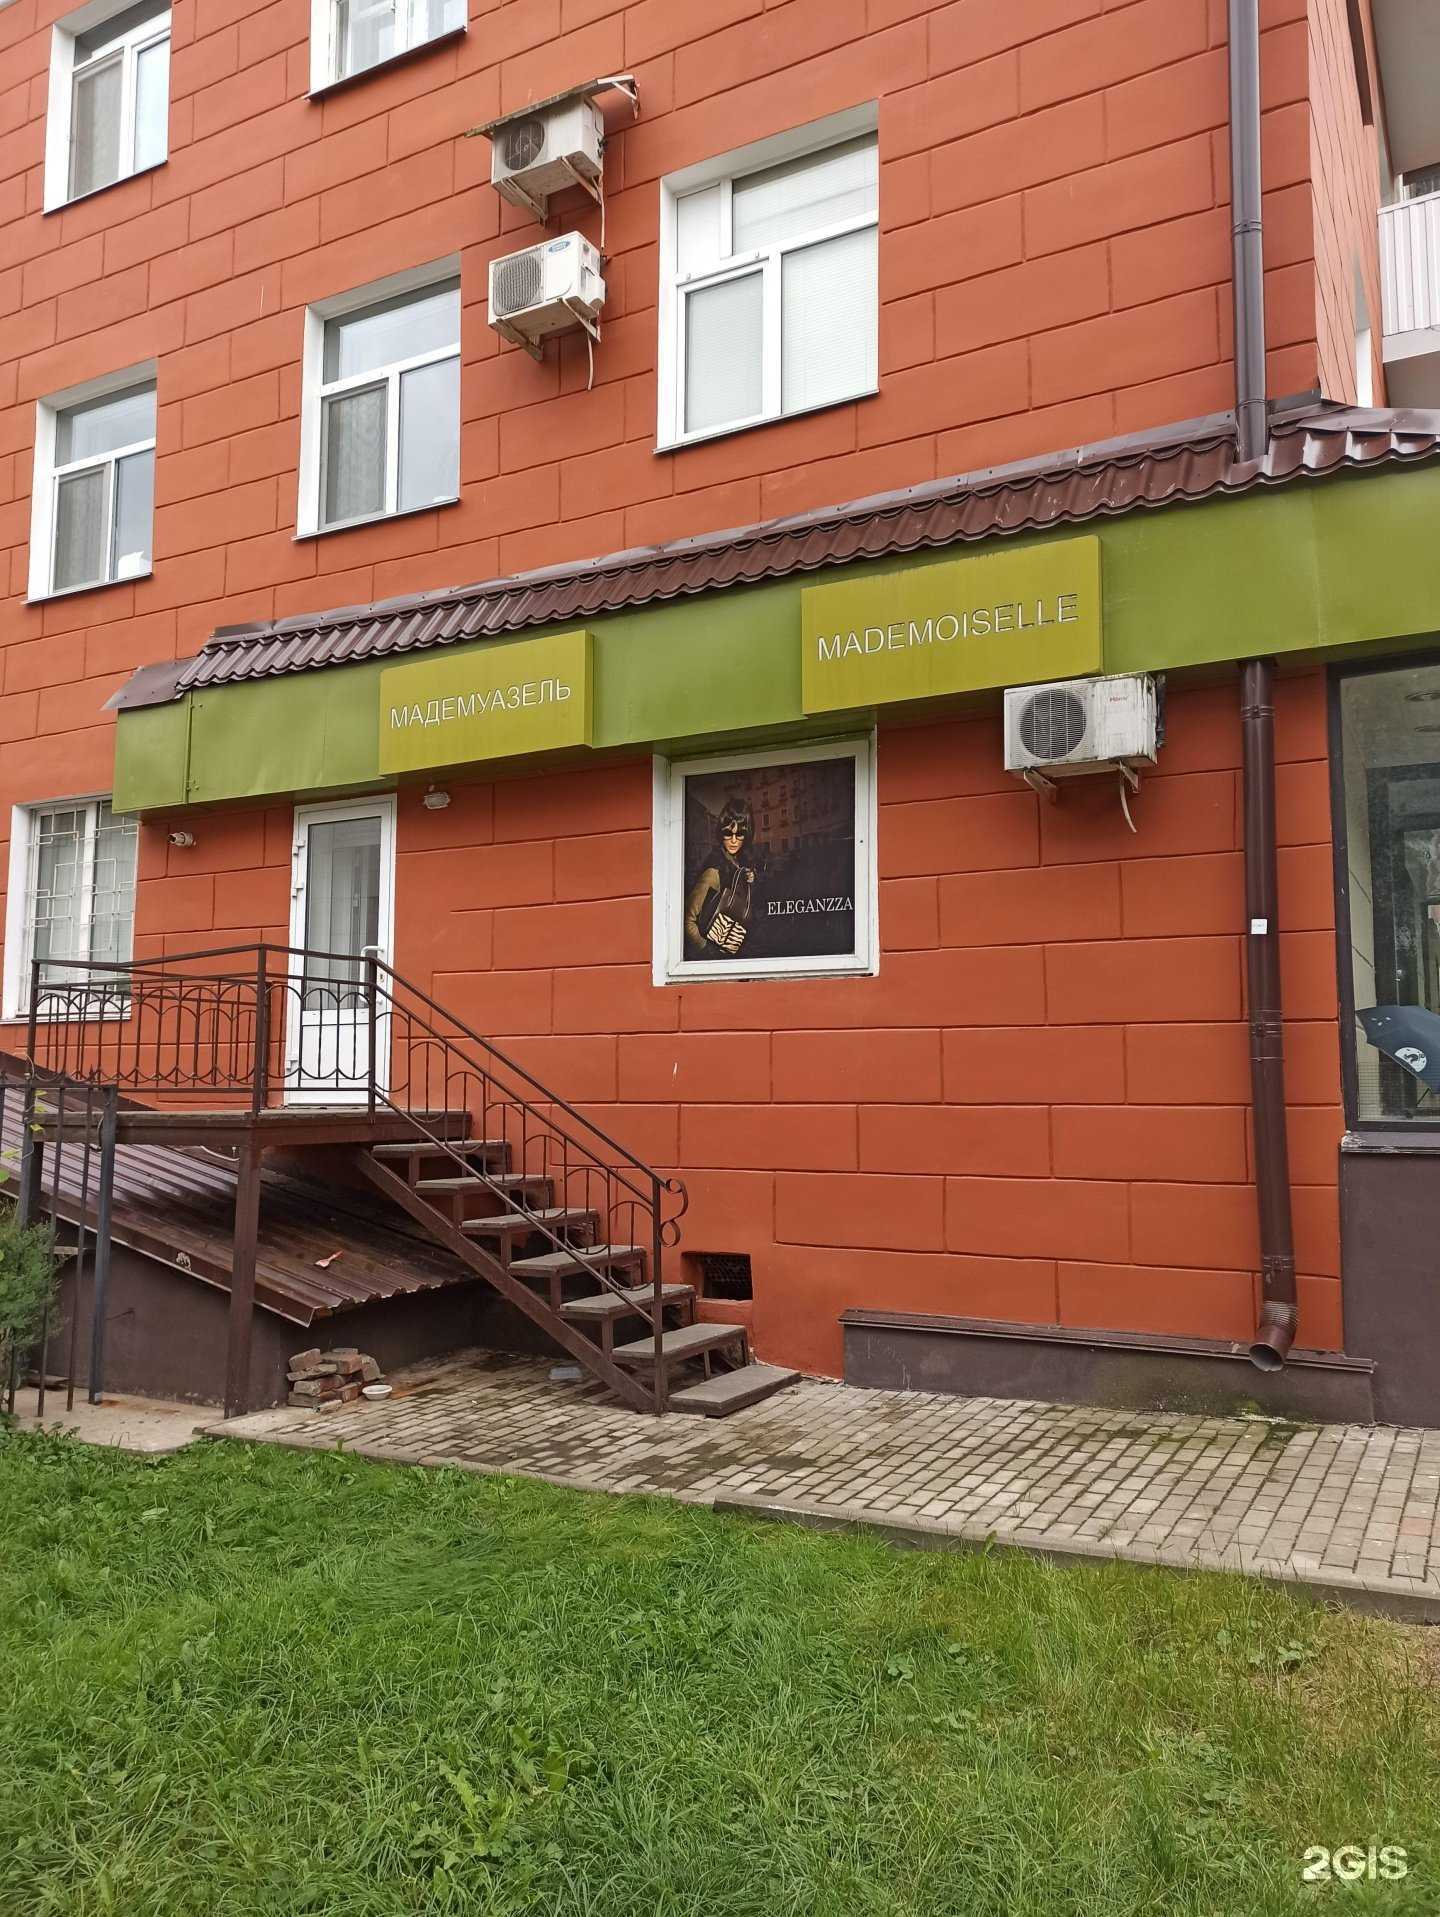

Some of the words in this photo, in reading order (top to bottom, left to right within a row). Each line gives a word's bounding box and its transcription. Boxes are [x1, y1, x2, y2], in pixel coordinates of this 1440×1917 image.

[817, 592, 1079, 662] MADEMOISELLE
[390, 678, 571, 729] МАДЕМУАЗЕЛЬ
[767, 897, 853, 915] ELEGANZZA
